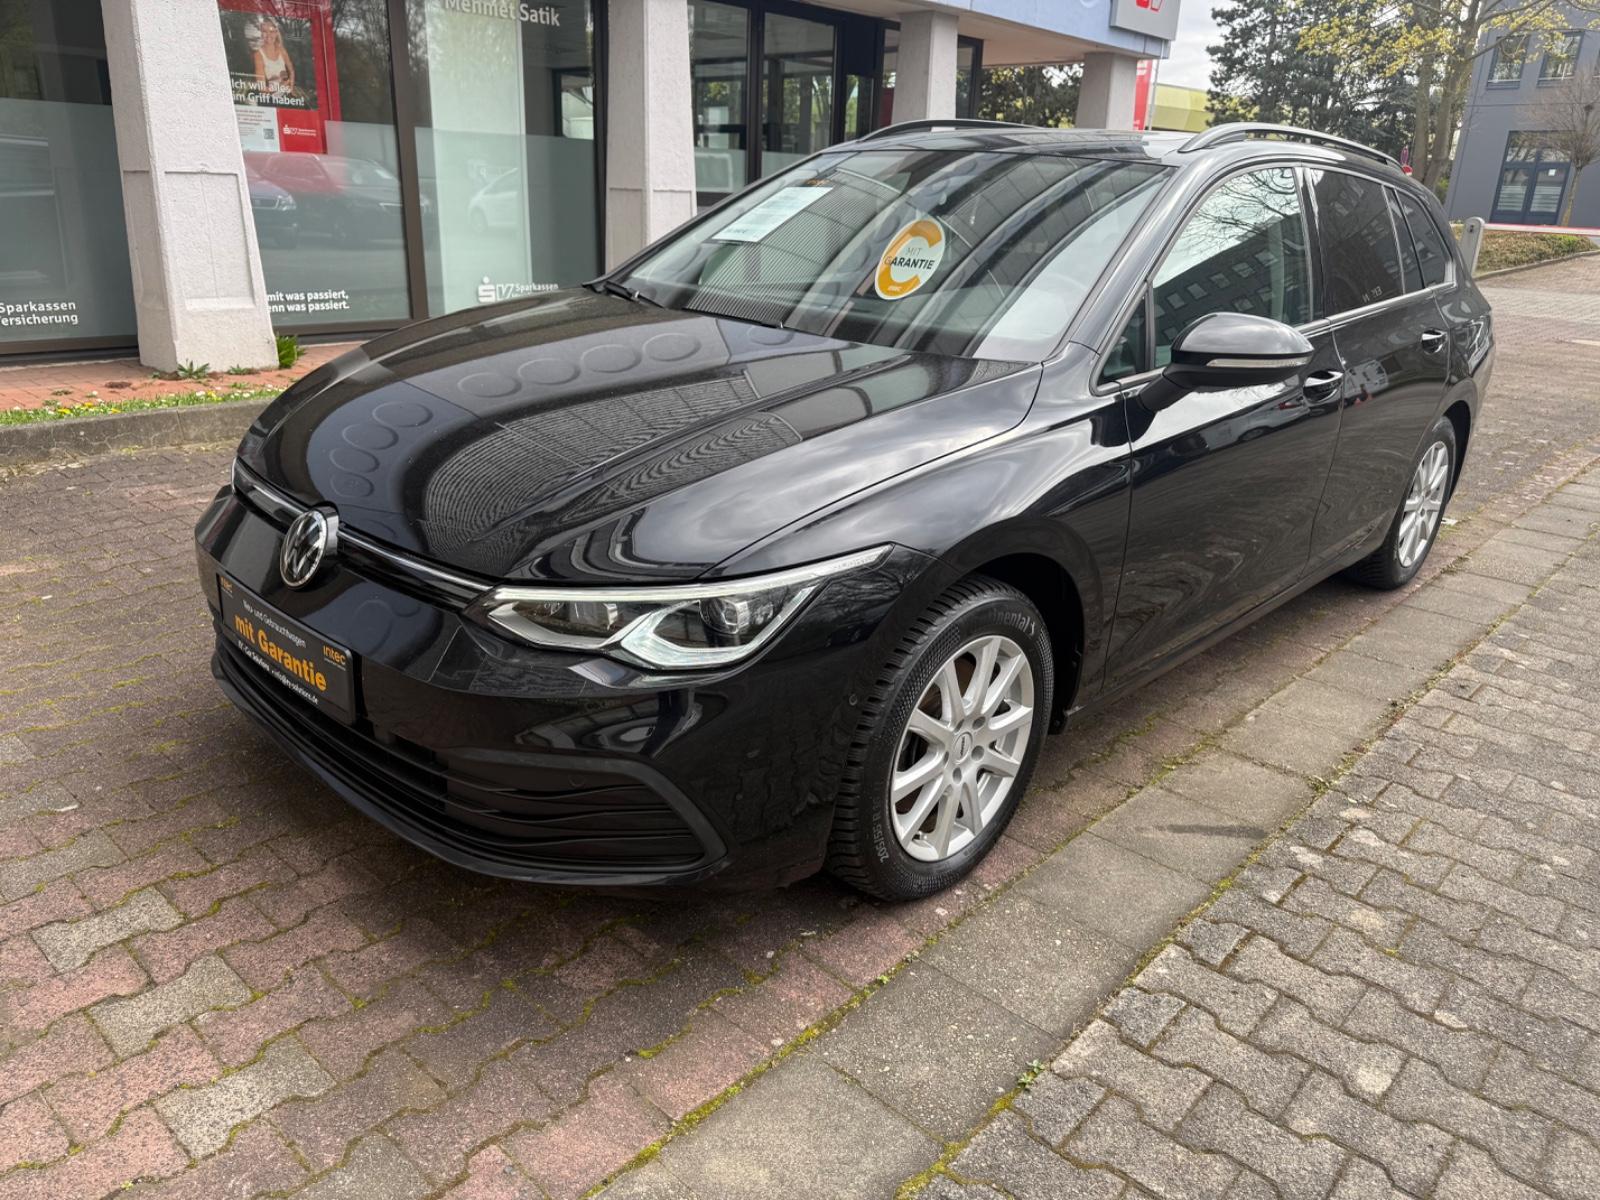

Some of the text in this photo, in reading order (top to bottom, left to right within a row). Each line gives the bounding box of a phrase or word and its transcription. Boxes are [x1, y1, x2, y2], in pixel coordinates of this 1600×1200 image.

[519, 3, 560, 26] Satik
[248, 80, 266, 90] will
[268, 83, 291, 93] alles
[247, 92, 270, 103] Griff
[272, 96, 305, 106] haben!
[884, 255, 935, 270] GARANTIE
[515, 282, 559, 293] Sparkassen
[286, 292, 305, 301] was
[307, 289, 349, 302] passiert,
[0, 301, 76, 316] Sparkassen
[287, 303, 306, 312] was
[308, 300, 350, 313] passiert.
[0, 313, 79, 326] ersicherung
[234, 614, 327, 691] mit Garantie
